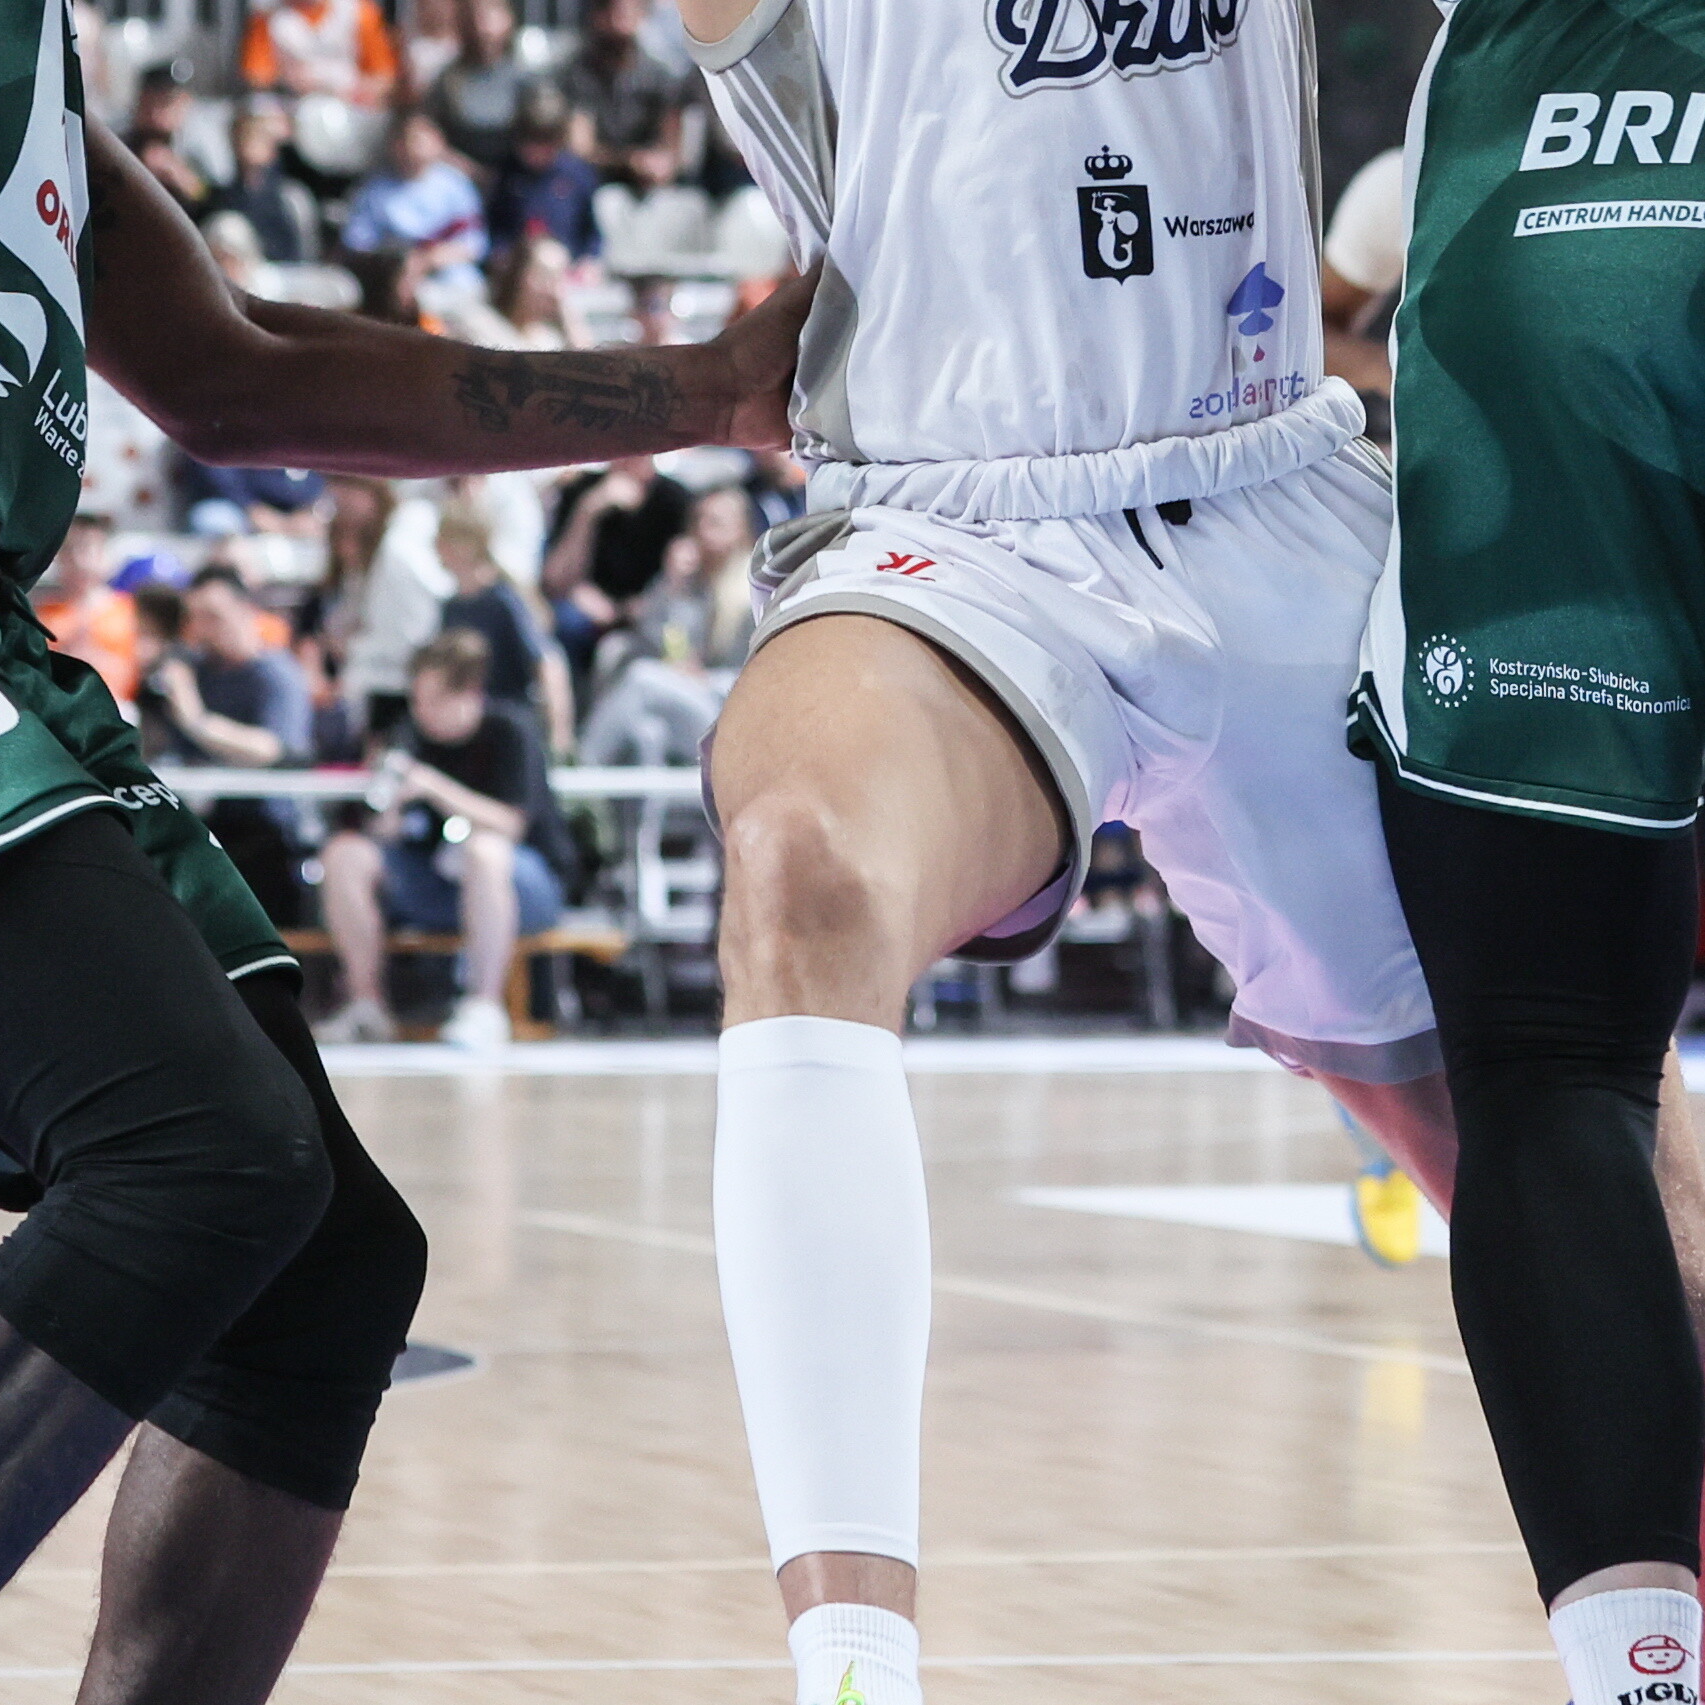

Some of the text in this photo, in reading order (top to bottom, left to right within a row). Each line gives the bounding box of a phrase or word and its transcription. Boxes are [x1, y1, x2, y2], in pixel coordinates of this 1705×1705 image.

[1523, 204, 1622, 230] CENTRUM
[1489, 657, 1650, 694] Kostrzyńsko-Słubicka
[1489, 678, 1566, 700] Specjalna
[1569, 685, 1614, 707] Strefa
